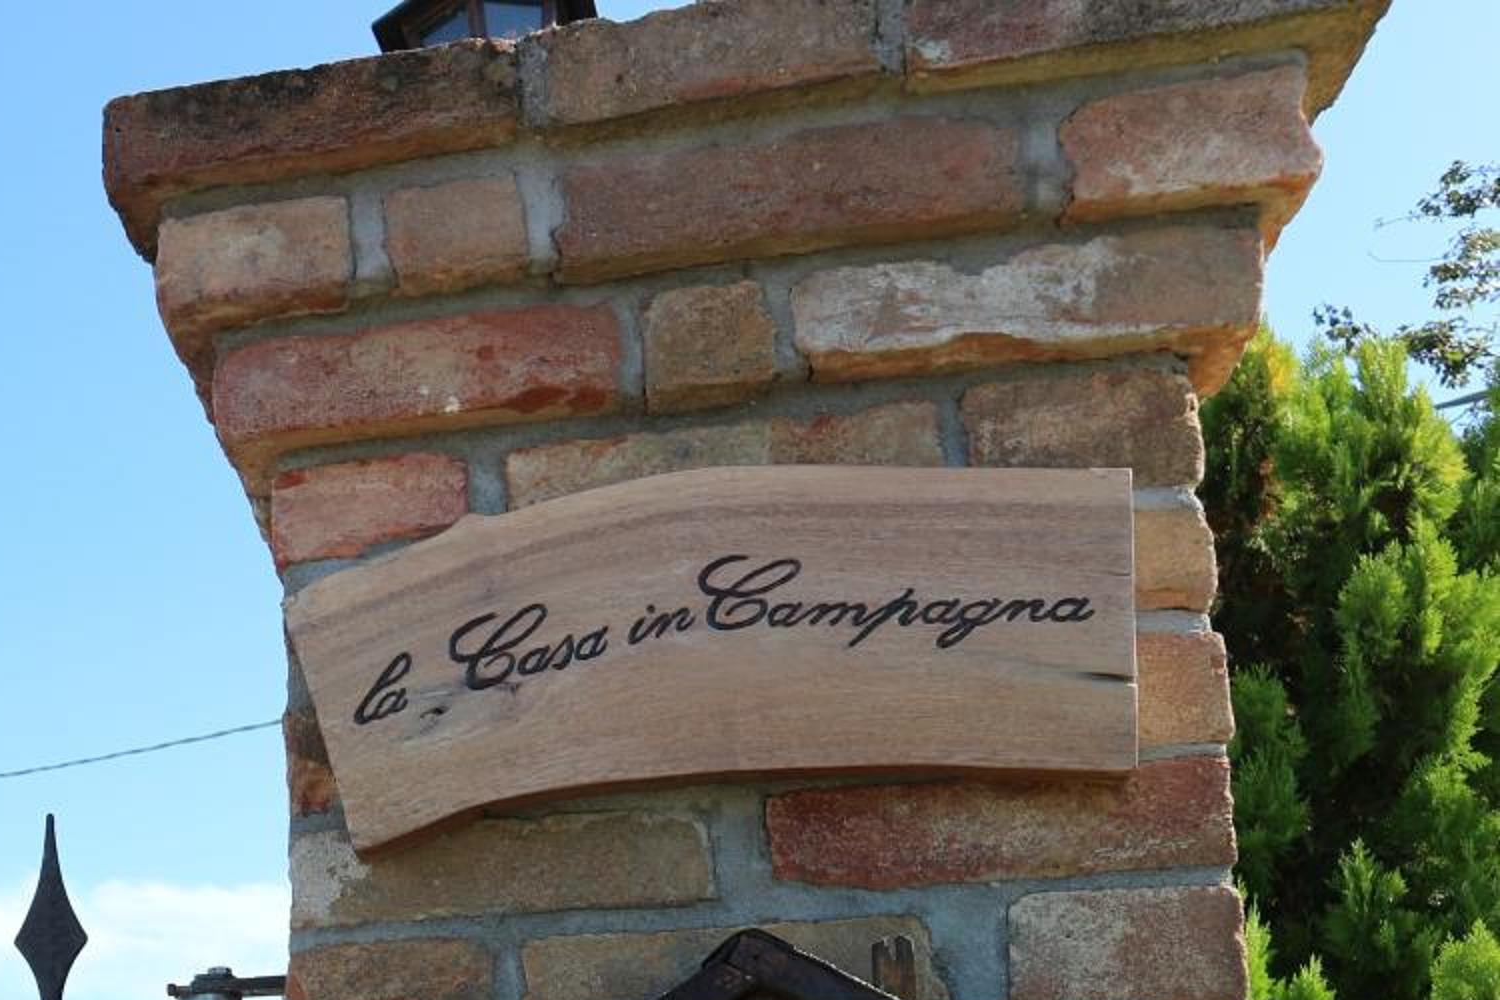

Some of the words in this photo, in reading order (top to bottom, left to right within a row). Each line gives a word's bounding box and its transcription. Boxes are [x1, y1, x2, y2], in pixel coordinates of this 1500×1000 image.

[449, 604, 607, 691] Casa
[628, 604, 696, 648] in
[698, 555, 1094, 649] Campagna
